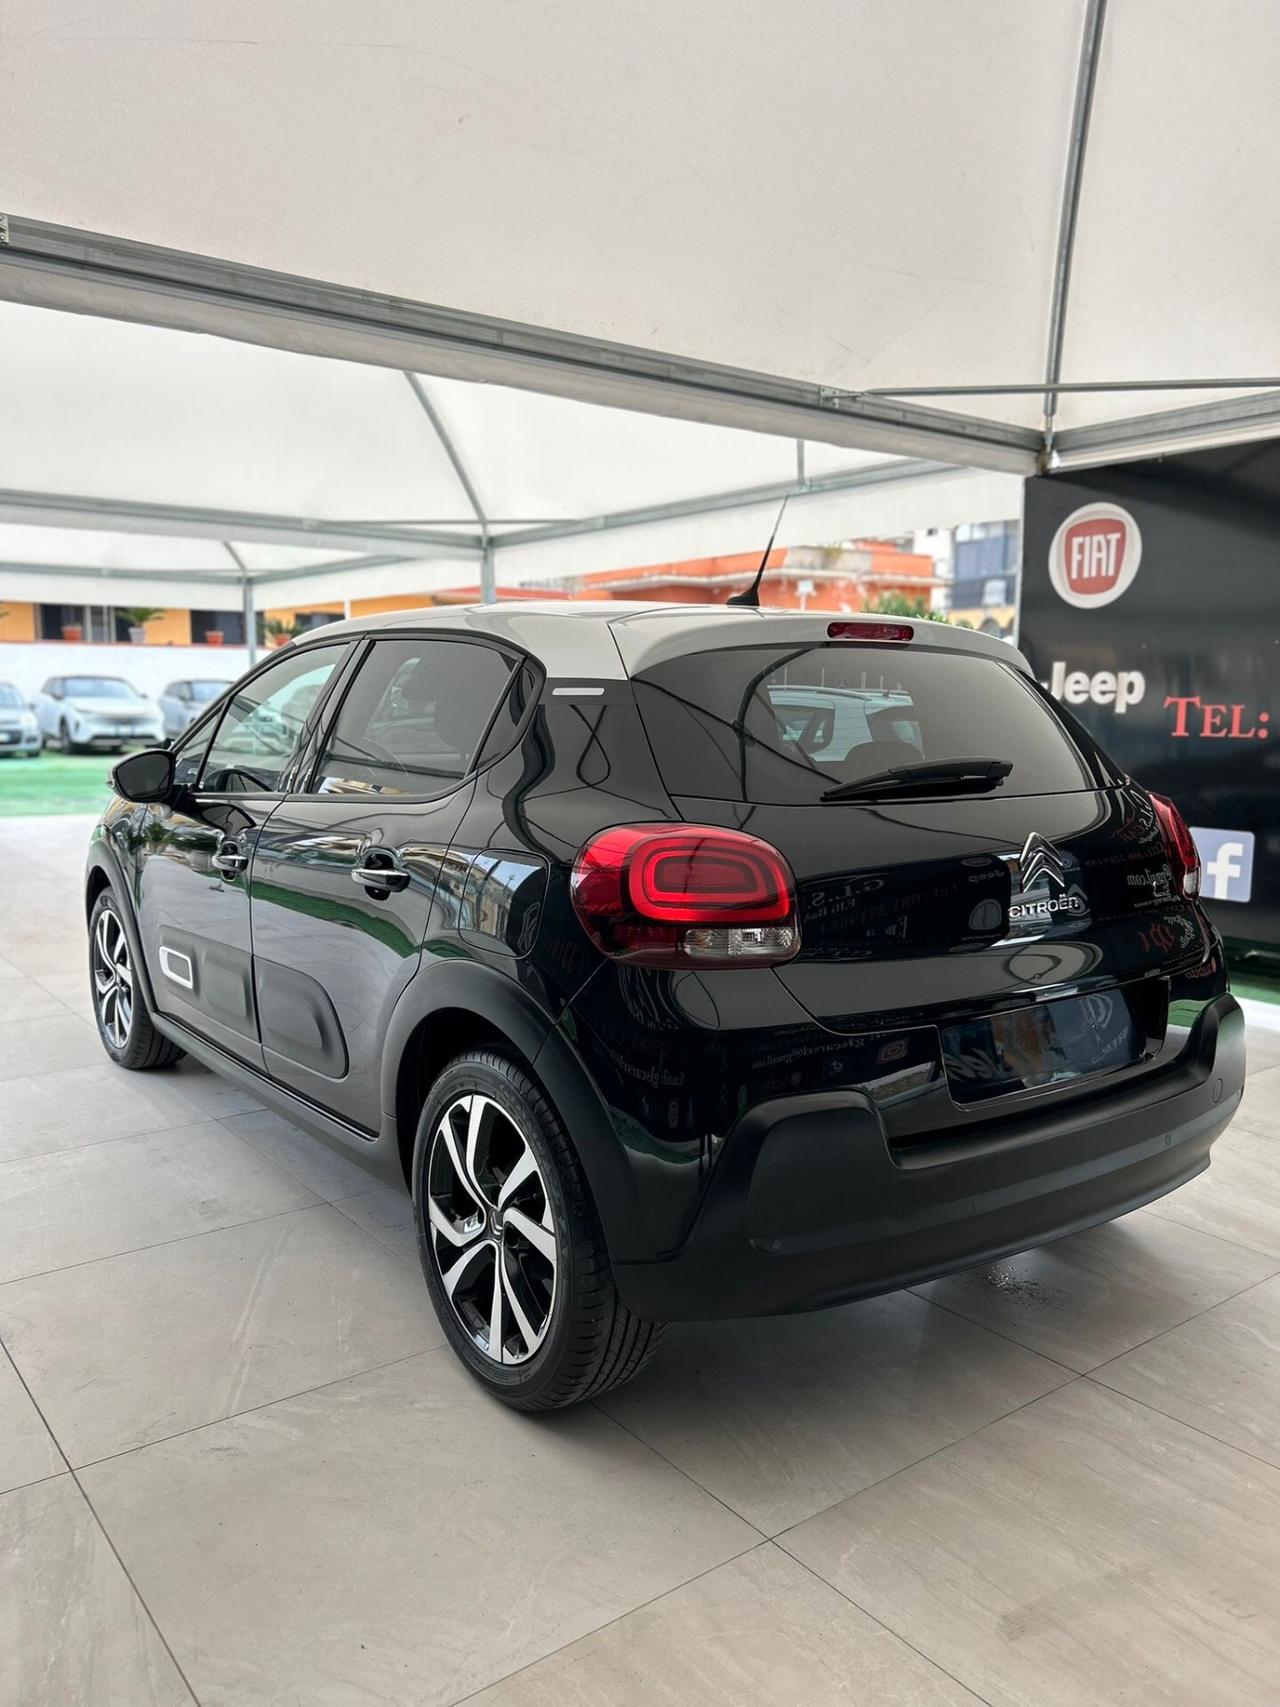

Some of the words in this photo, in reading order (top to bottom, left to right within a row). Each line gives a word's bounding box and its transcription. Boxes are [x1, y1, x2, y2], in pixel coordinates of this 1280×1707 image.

[1071, 532, 1121, 580] FIAT
[1041, 661, 1146, 714] Jeep
[1163, 696, 1270, 738] TEL:
[1008, 893, 1079, 918] CITROËN
